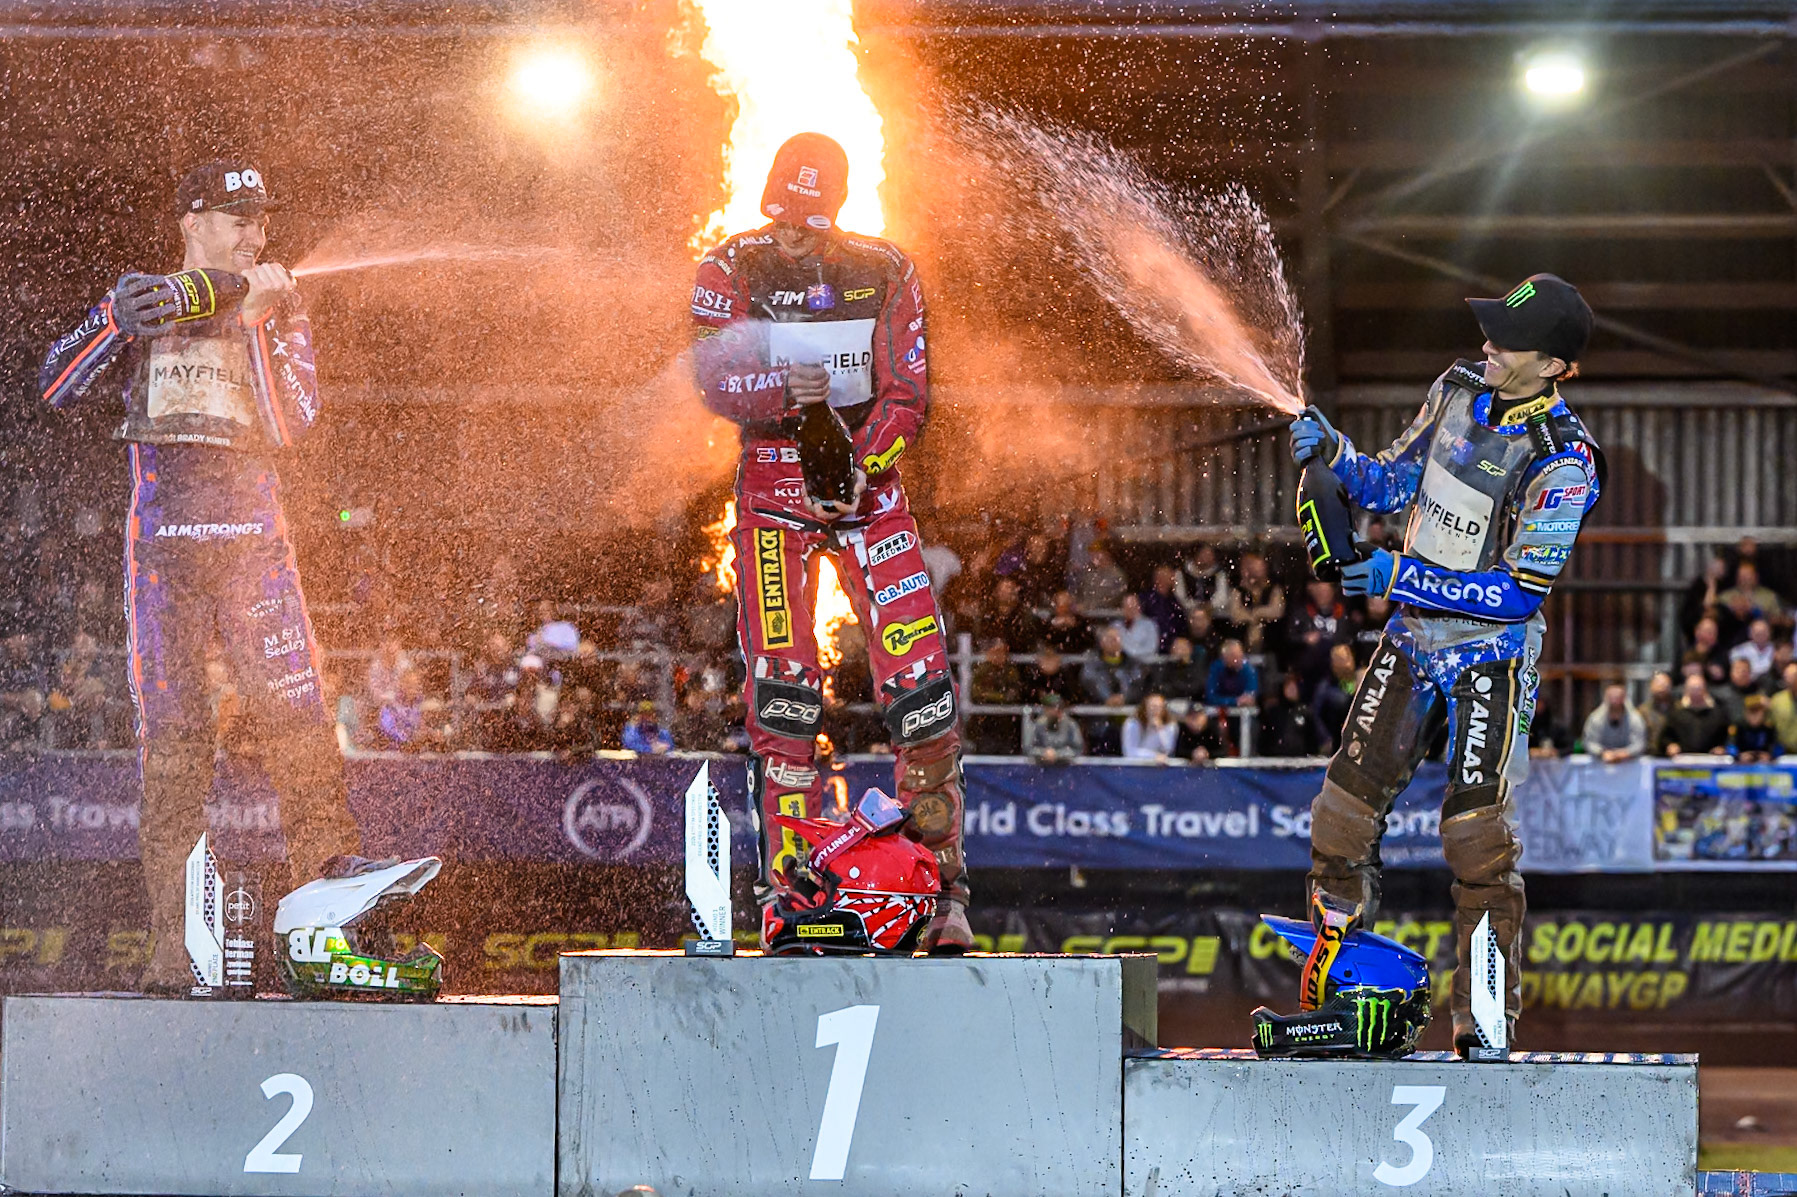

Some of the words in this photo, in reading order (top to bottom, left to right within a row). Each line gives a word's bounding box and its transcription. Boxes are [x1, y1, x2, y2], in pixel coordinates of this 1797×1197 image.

[224, 168, 266, 193] BO
[787, 183, 821, 198] BETARD
[178, 273, 200, 306] SGP
[693, 286, 733, 311] PSH
[770, 291, 805, 306] FIM
[843, 287, 876, 302] SGP
[775, 350, 871, 370] MFIELD
[1453, 365, 1487, 385] MONSTE
[1477, 459, 1507, 477] SGP
[1533, 488, 1564, 511] JG
[1564, 485, 1586, 497] SPORT
[155, 522, 264, 537] ARMSTRONG'S
[1537, 520, 1580, 532] MOTORE
[871, 542, 910, 564] SPEEDWAY
[760, 530, 784, 608] ENTRACK
[263, 635, 279, 649] M
[264, 637, 306, 659] Sealey
[1356, 651, 1398, 736] ANLAS
[760, 698, 822, 724] pod
[901, 690, 953, 738] pod
[1461, 700, 1492, 785] ANLAS
[964, 802, 1016, 835] rld
[1027, 802, 1130, 836] Class
[1139, 803, 1260, 837] Travel
[809, 926, 841, 935] ENTRACK
[1529, 921, 1679, 963] SOCIAL
[696, 941, 722, 950] SGP
[1305, 946, 1331, 1008] SCOT
[1286, 1021, 1343, 1036] MONSTER
[1477, 1049, 1501, 1058] SGP
[808, 1004, 881, 1181] 1
[242, 1072, 315, 1174] 2
[1371, 1085, 1448, 1187] 3
